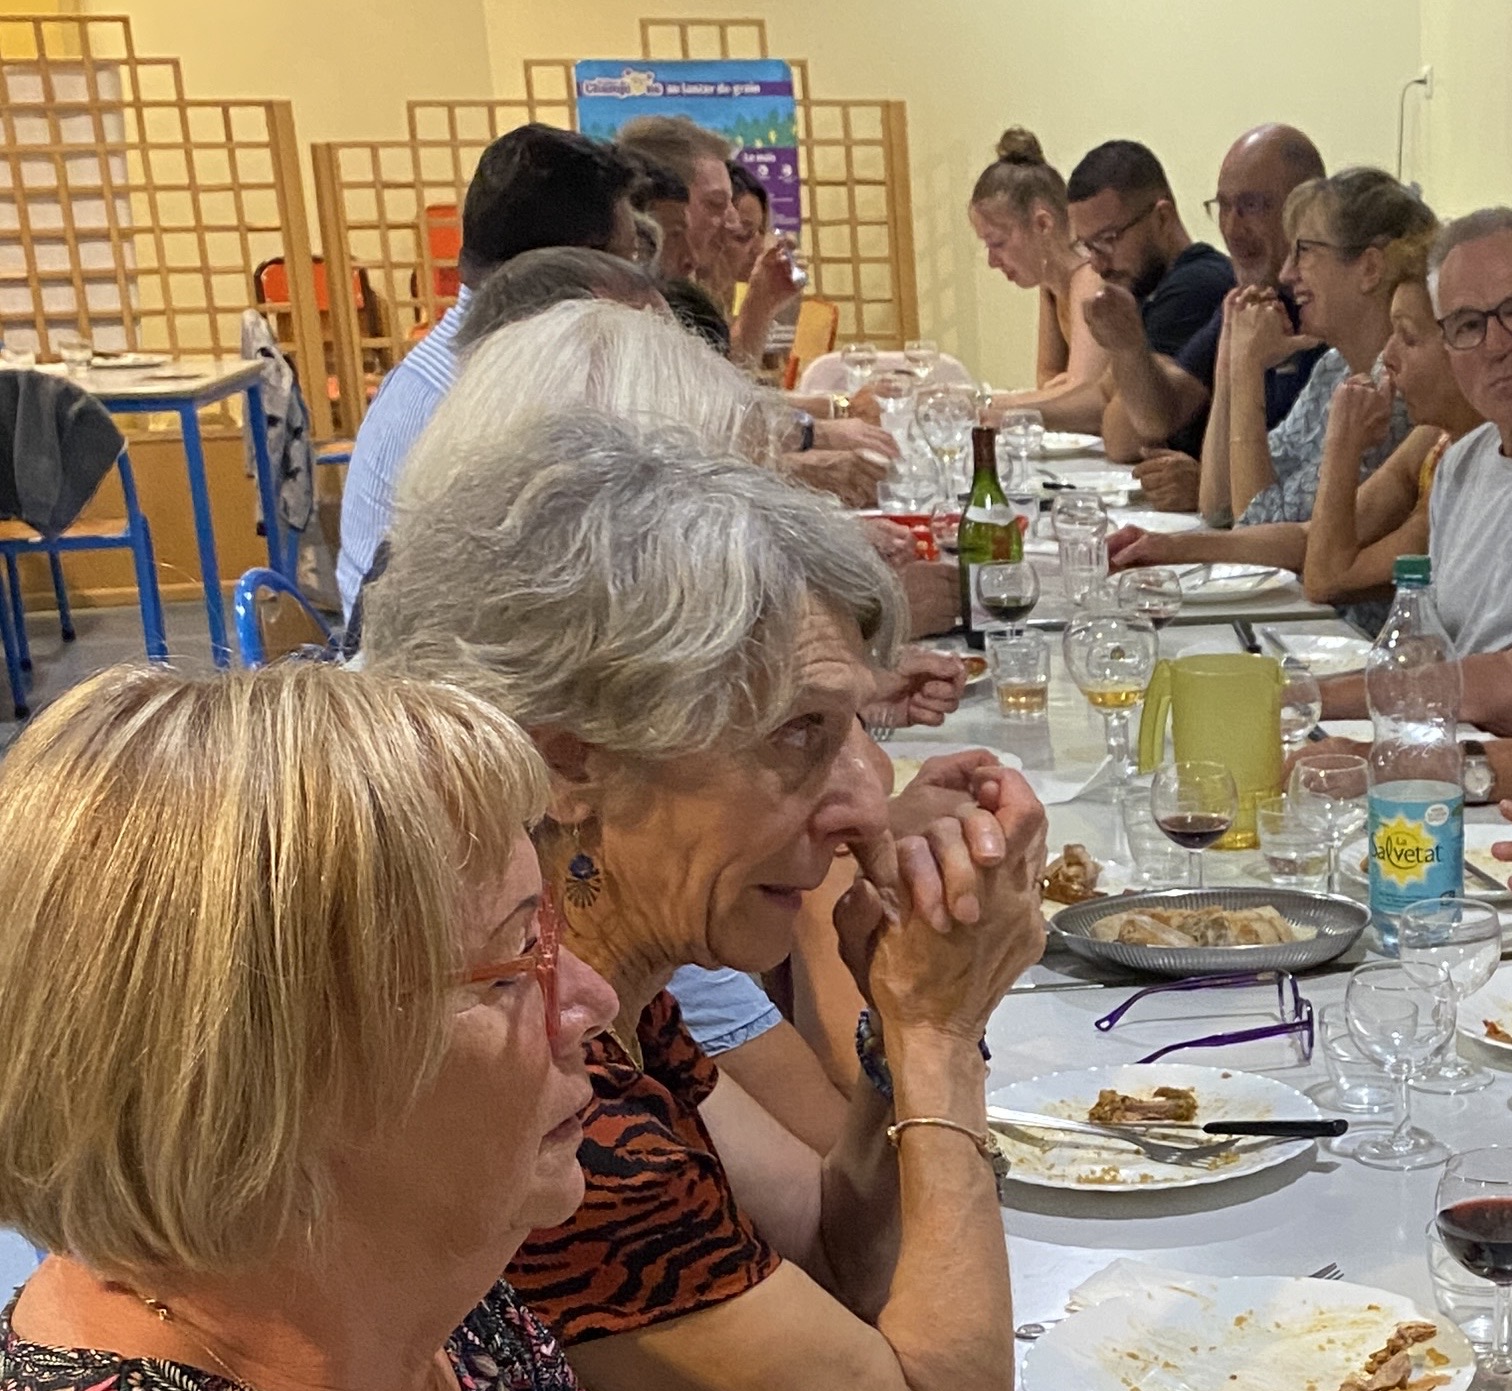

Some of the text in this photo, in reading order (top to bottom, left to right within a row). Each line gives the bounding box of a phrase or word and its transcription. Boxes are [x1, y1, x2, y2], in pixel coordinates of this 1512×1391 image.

[584, 82, 661, 95] Champins
[1395, 836, 1408, 847] La
[1370, 832, 1444, 869] Salvetat
